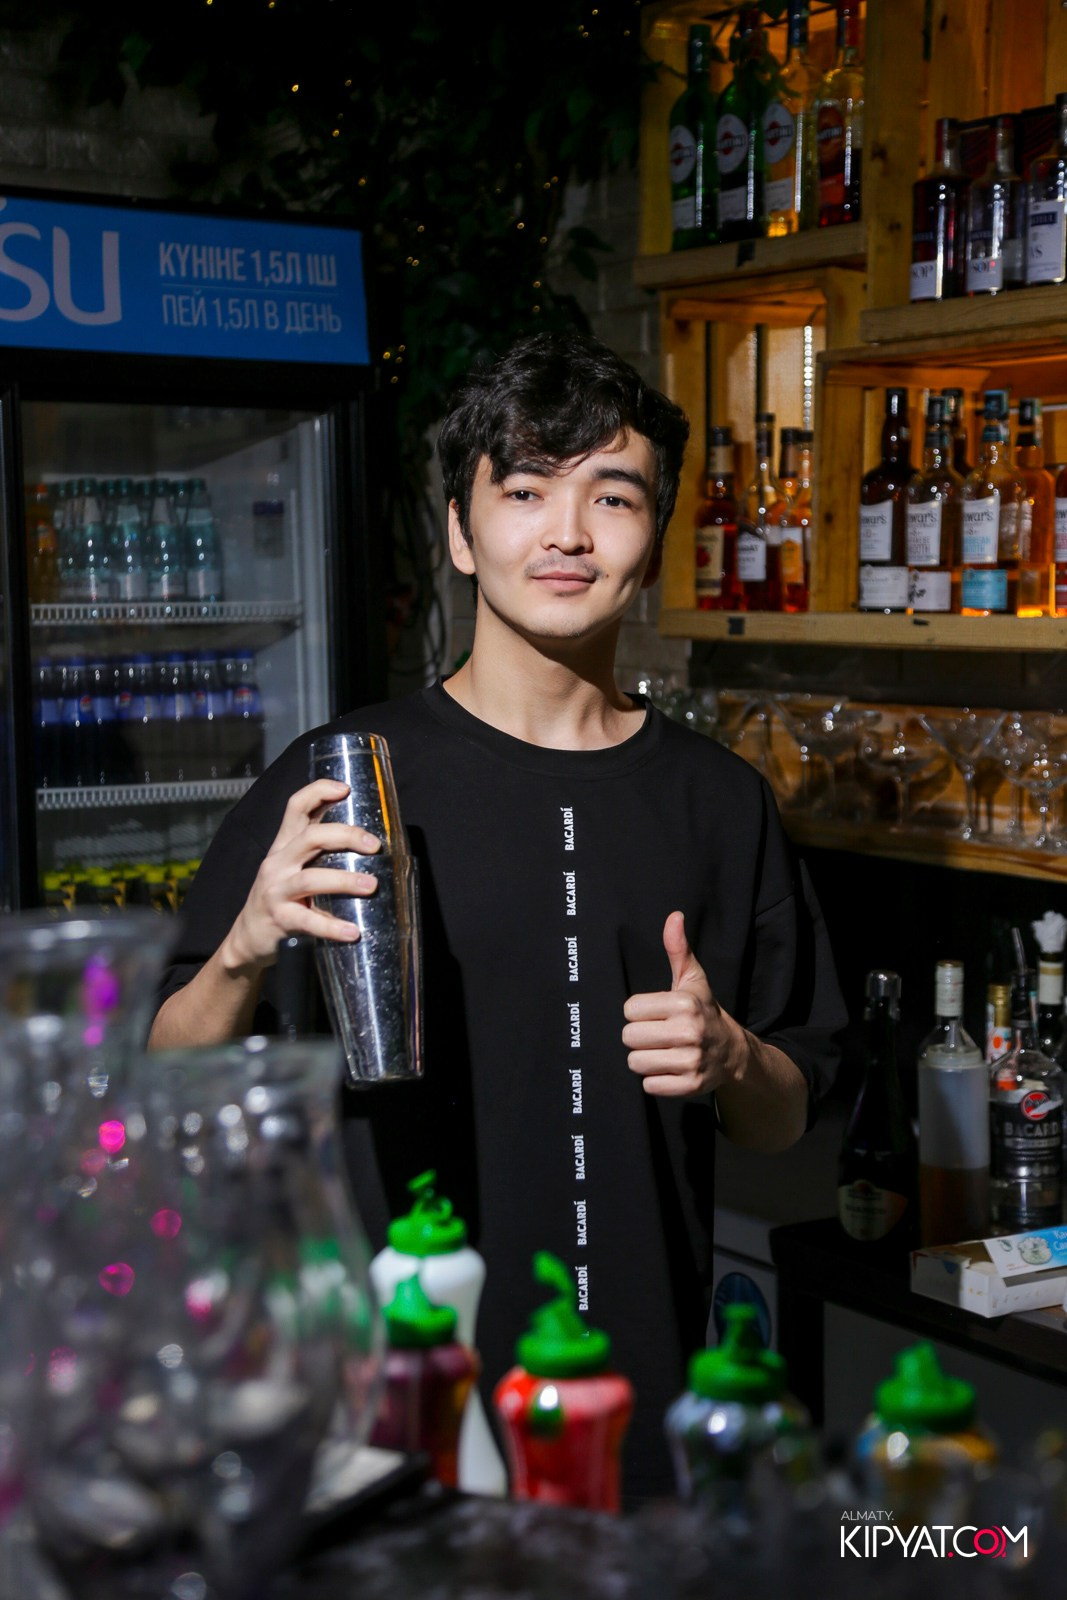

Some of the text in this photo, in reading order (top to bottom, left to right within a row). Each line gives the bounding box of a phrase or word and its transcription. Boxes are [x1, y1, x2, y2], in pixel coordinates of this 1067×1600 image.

[250, 249, 303, 287] 1,5Л
[161, 288, 342, 335] ПЕЙ 1,5Л В ДЕНЬ
